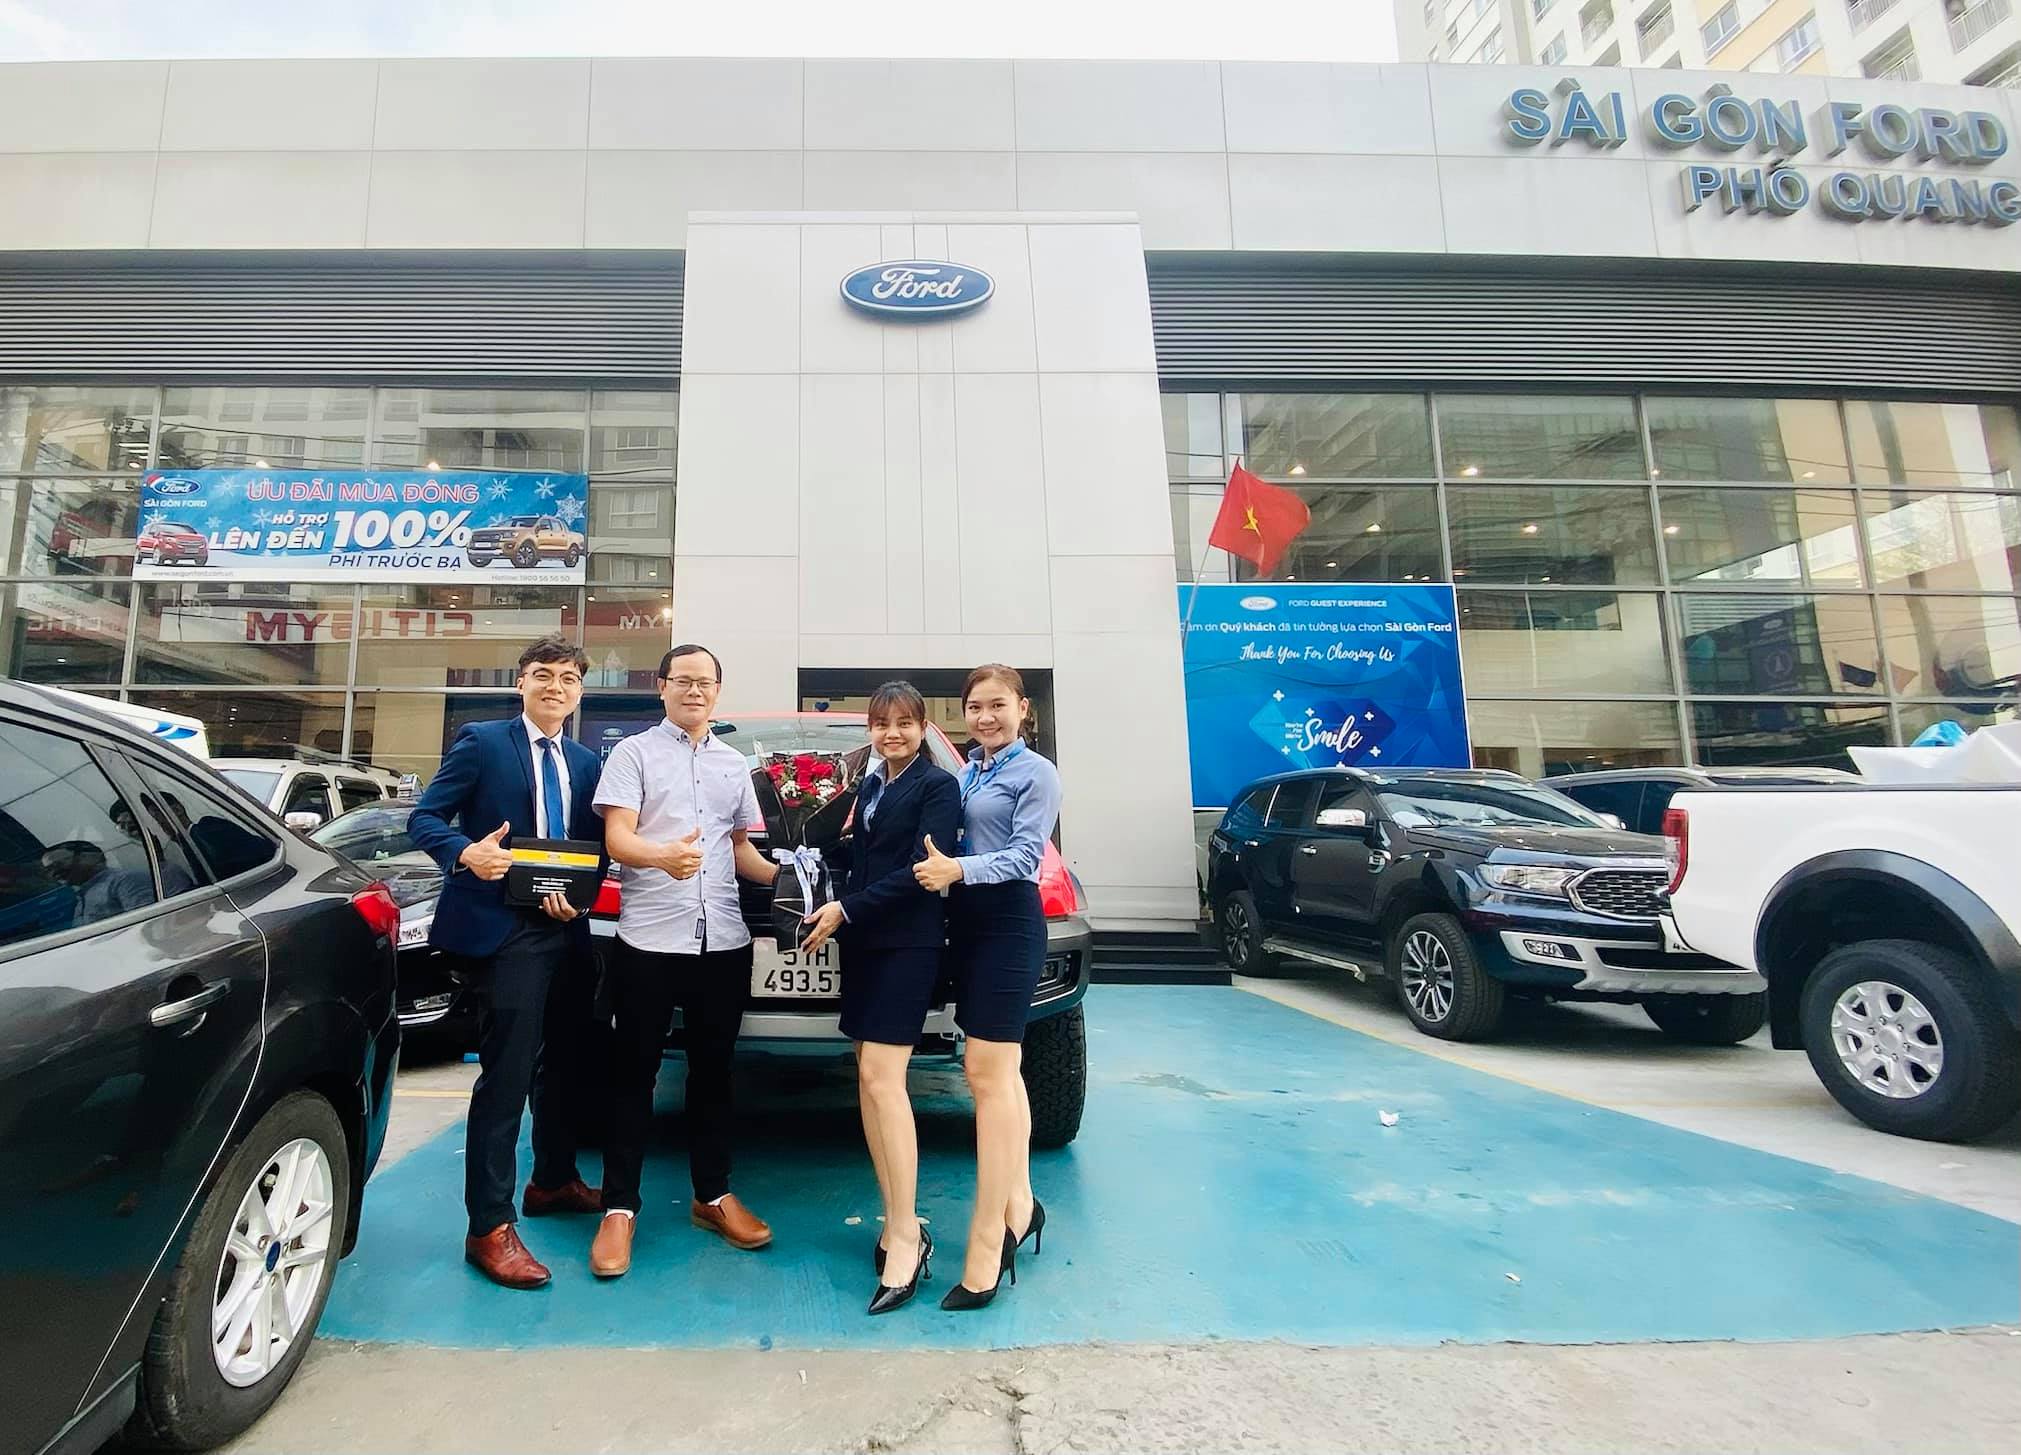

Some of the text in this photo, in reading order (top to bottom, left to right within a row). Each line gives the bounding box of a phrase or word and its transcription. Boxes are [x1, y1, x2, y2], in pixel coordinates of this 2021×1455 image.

[1815, 101, 2009, 162] FORD
[1821, 172, 2021, 224] QUANG
[872, 267, 964, 299] Ford
[247, 477, 480, 503] ƯU ĐÃI MÙA ĐÔNG
[182, 499, 207, 508] FORD
[208, 525, 325, 549] LÊN ĐẾN
[333, 509, 472, 549] 100%
[328, 551, 364, 567] PHÍ
[437, 556, 461, 571] BẠ
[1310, 599, 1337, 607] GUEST
[1338, 599, 1387, 607] EXPERIENCE
[1243, 621, 1276, 632] khách
[1427, 622, 1452, 632] Ford
[1240, 641, 1395, 666] Thank You For Choosing Us
[1297, 714, 1363, 753] Smile
[764, 969, 841, 993] 493.5
